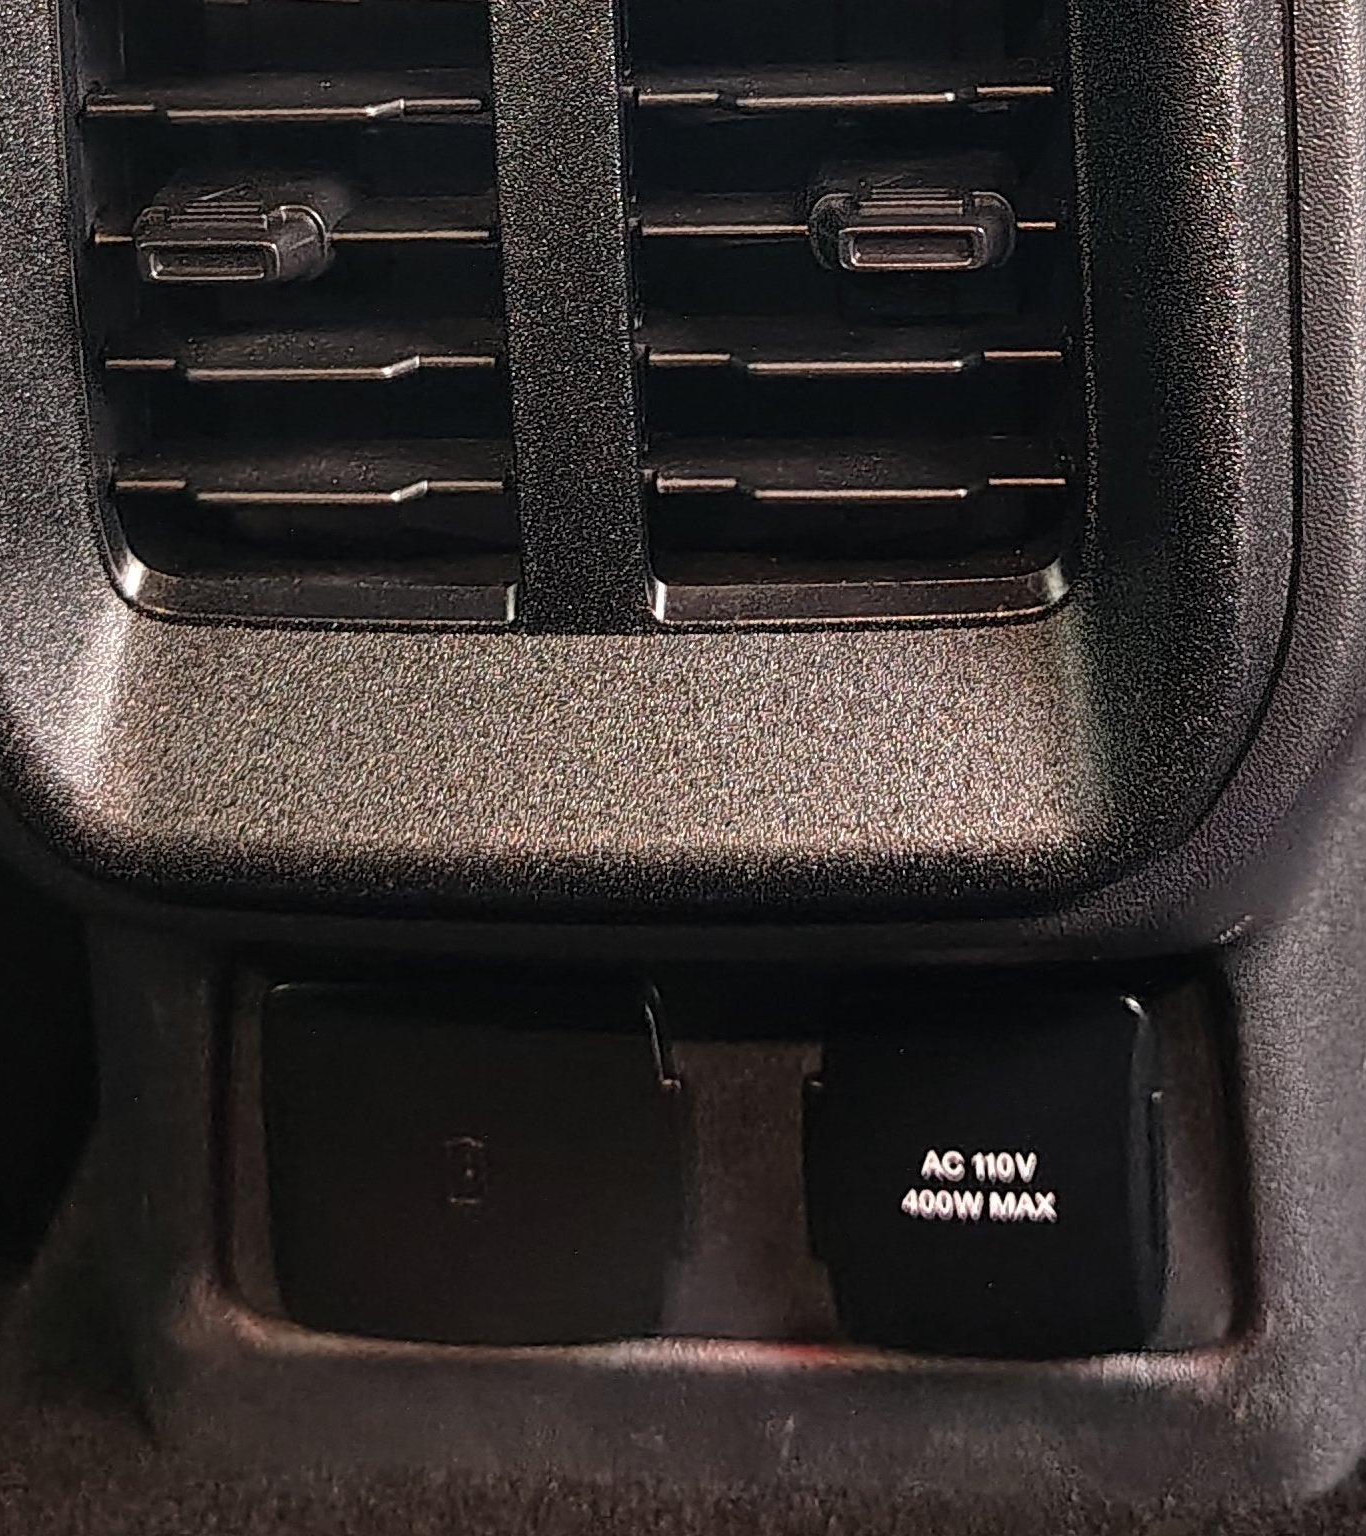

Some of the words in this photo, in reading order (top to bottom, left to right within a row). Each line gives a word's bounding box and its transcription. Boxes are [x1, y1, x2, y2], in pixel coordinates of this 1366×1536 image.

[921, 1149, 965, 1182] AC
[971, 1151, 1037, 1183] 110V
[901, 1188, 984, 1221] 400W
[989, 1191, 1057, 1223] MAX
